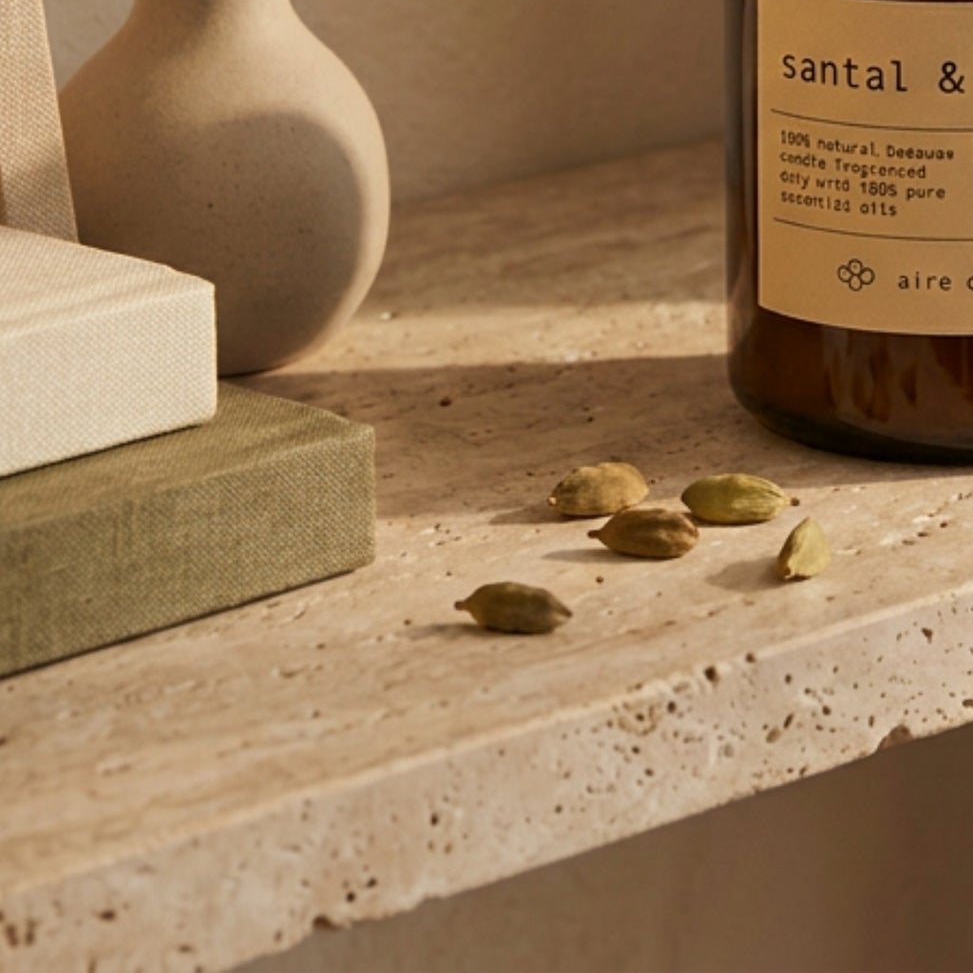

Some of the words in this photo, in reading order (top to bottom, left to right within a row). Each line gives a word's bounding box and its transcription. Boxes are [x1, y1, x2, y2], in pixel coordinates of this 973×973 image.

[782, 53, 909, 93] santal
[937, 61, 966, 94] &
[906, 186, 946, 201] pure
[897, 271, 953, 291] aire
